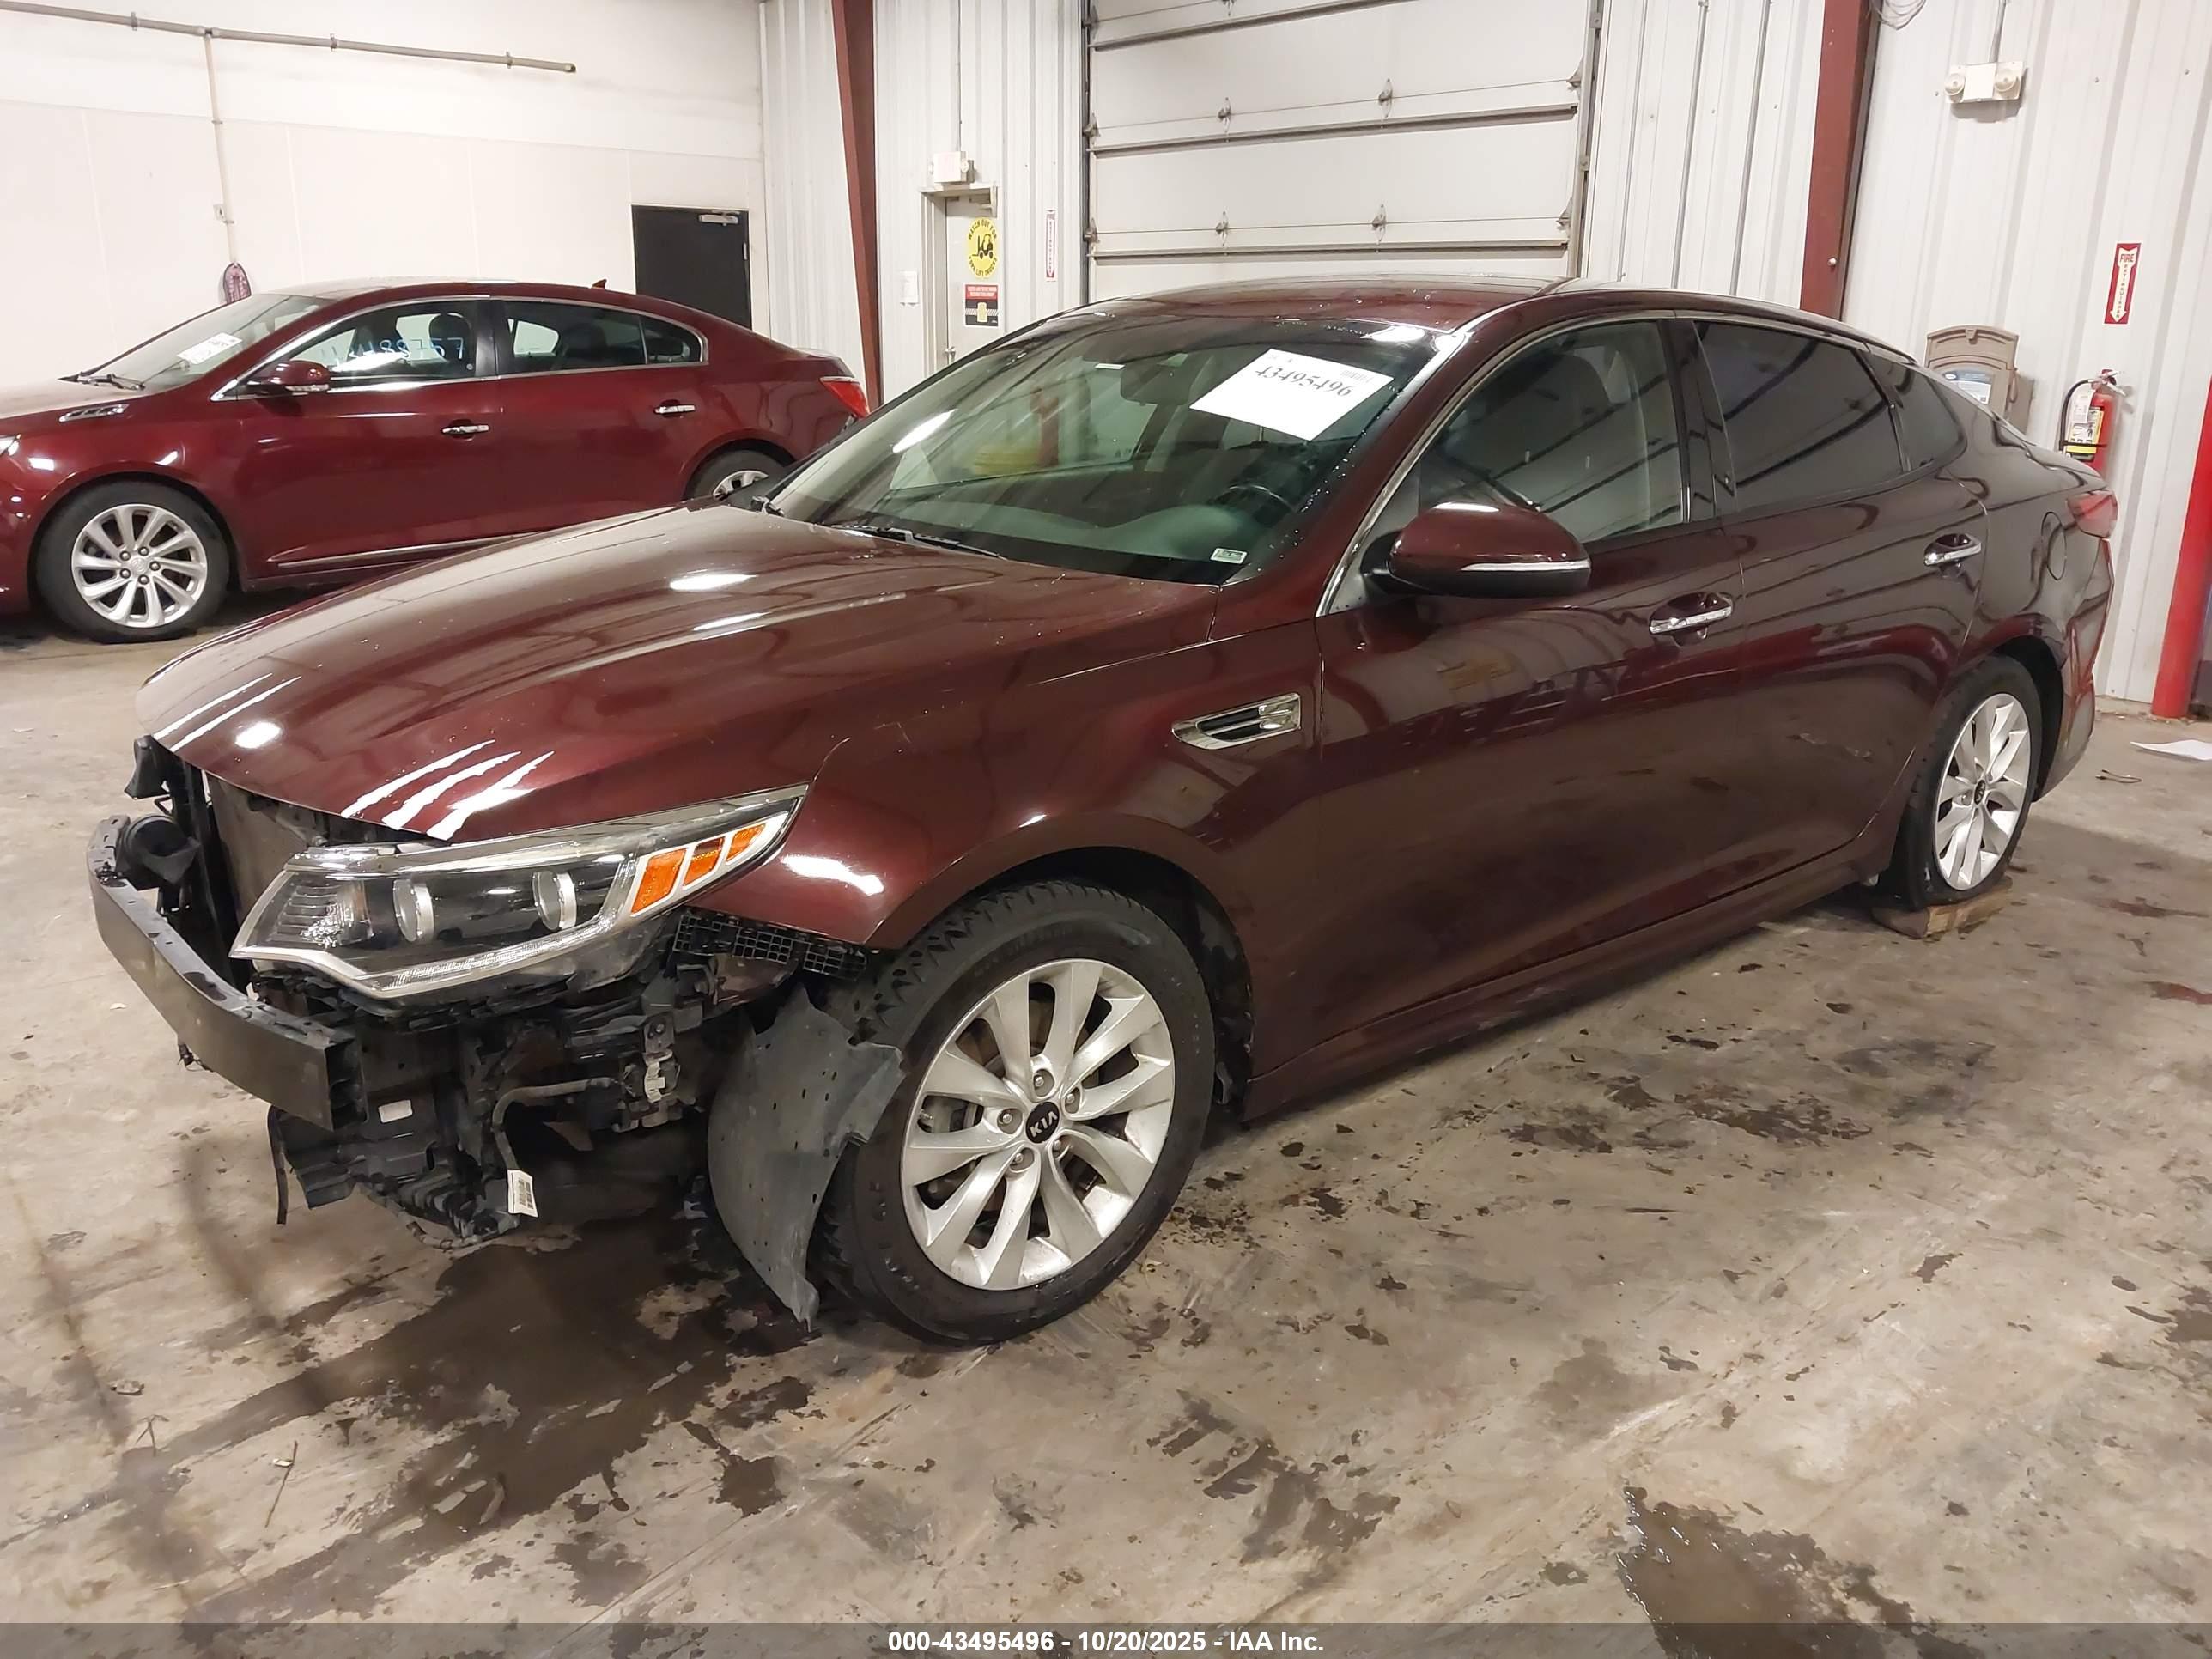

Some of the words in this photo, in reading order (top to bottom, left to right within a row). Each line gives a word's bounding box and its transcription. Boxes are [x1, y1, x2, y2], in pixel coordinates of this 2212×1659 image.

[2119, 253, 2135, 263] FIRE
[1255, 365, 1354, 397] 43495496
[1030, 1110, 1058, 1138] KIA
